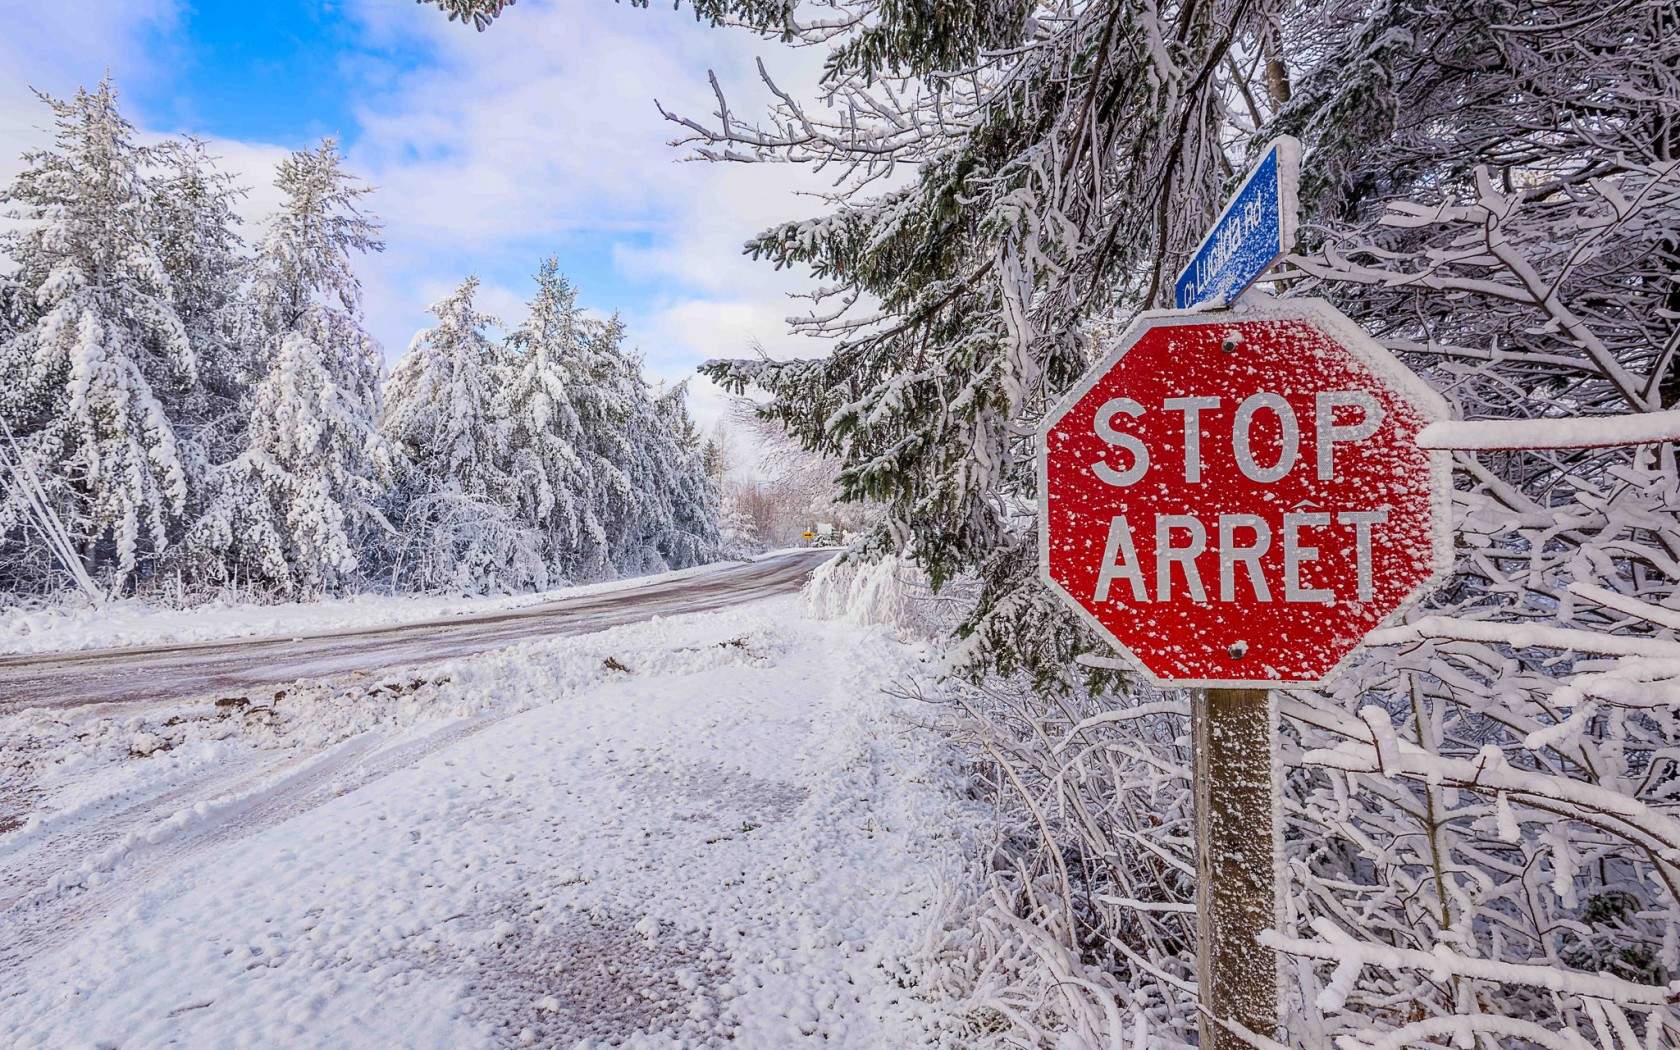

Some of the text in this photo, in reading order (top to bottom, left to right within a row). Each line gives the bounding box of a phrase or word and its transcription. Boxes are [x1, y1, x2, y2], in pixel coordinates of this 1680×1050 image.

[1245, 190, 1262, 238] Rd
[1091, 391, 1384, 487] STOP
[1093, 499, 1389, 602] ARRÊT
